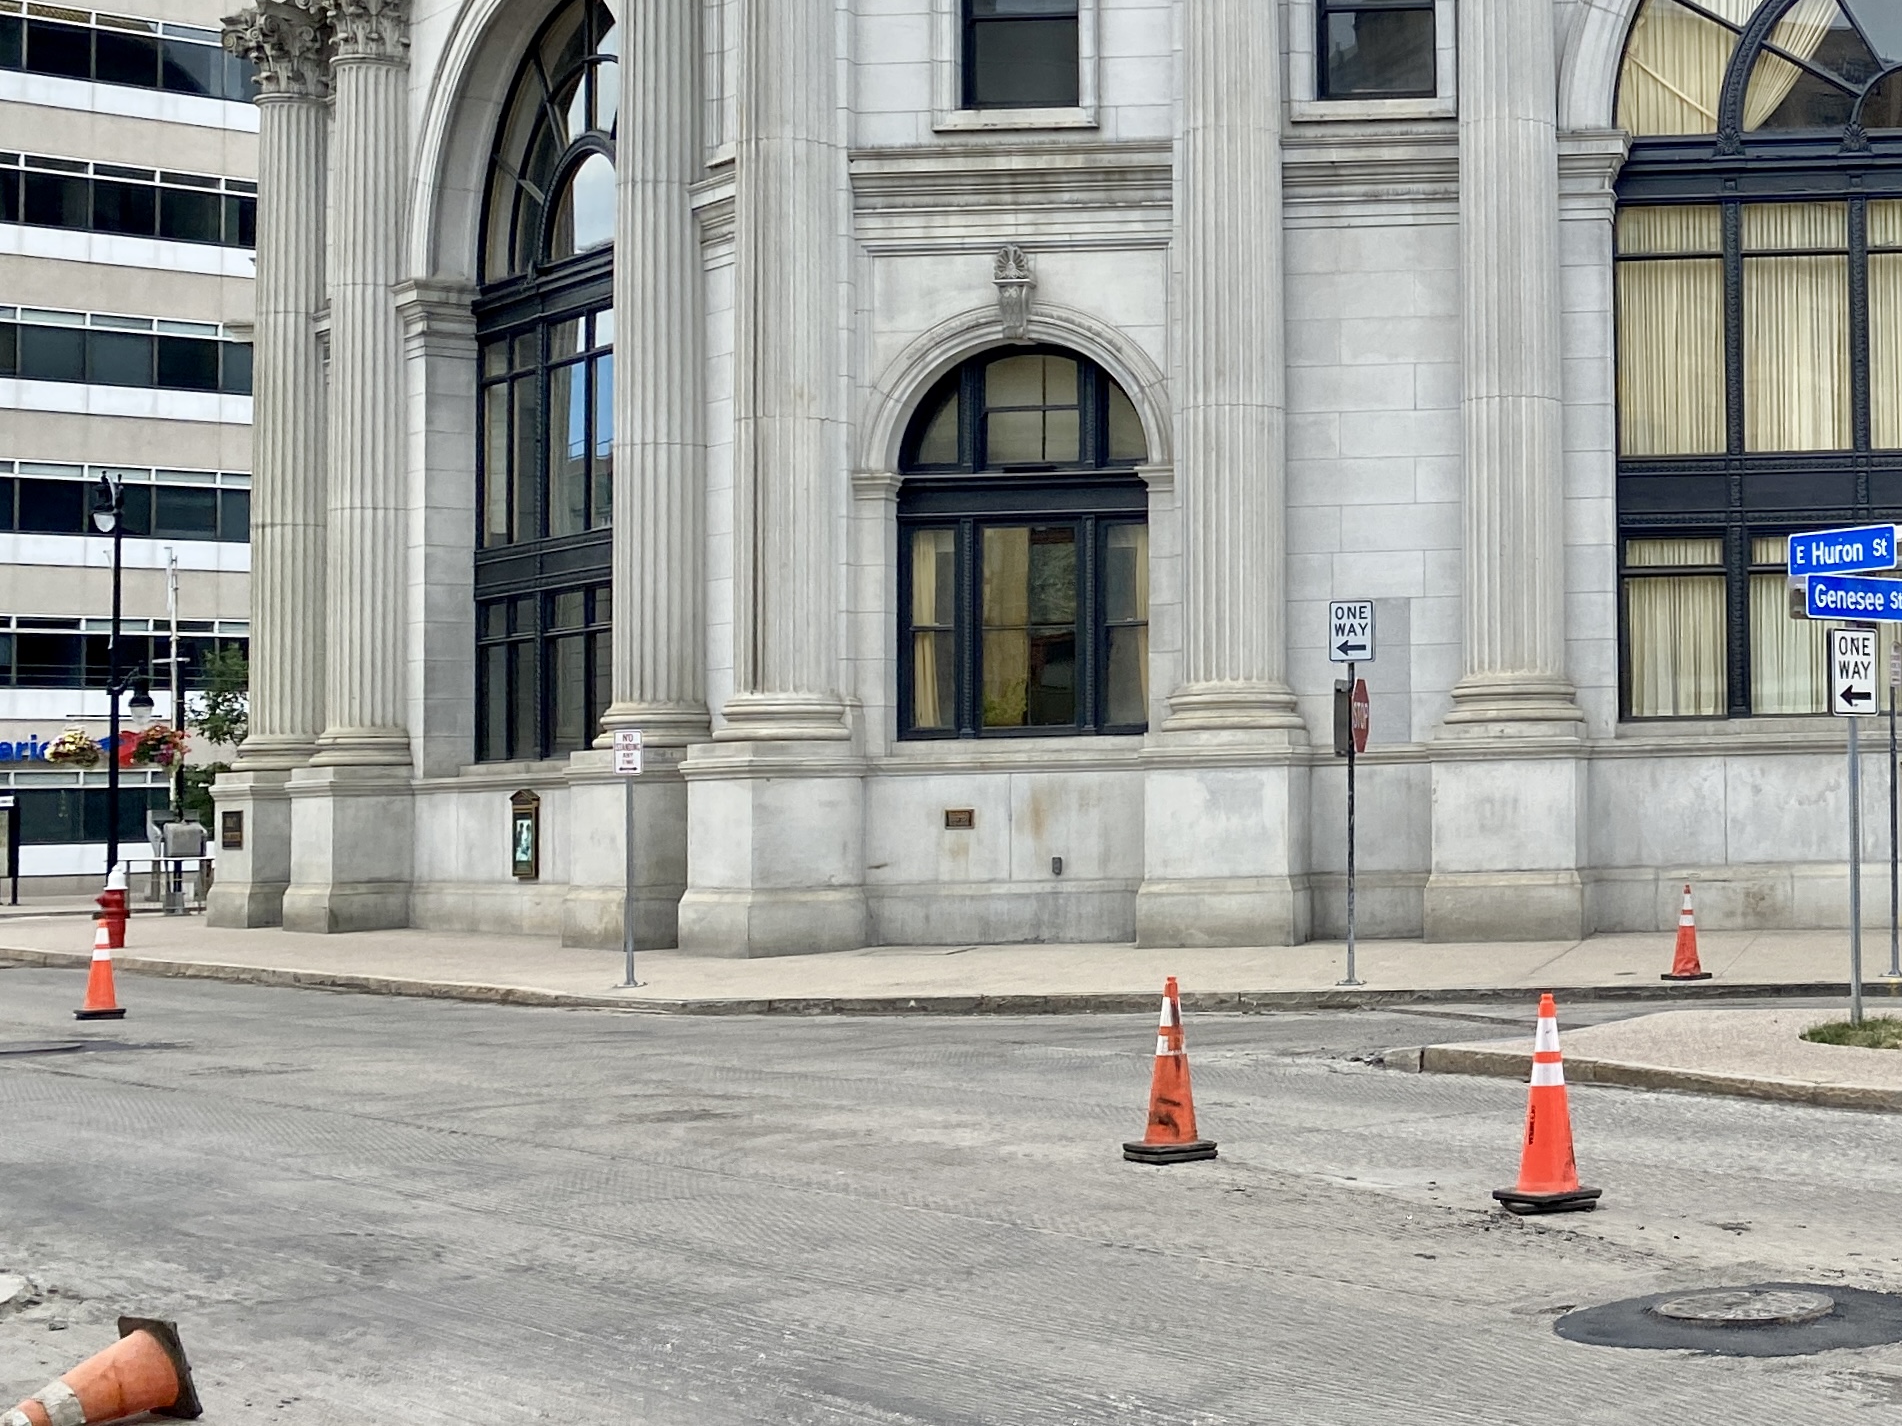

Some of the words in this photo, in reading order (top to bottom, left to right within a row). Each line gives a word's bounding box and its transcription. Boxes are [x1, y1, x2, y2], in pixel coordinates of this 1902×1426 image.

[1796, 546, 1806, 565] E
[1812, 541, 1864, 566] Huron
[1872, 537, 1888, 558] St
[1814, 583, 1885, 611] Genesee
[1334, 605, 1369, 621] ONE
[1334, 622, 1369, 637] WAY
[1838, 636, 1871, 657] ONE
[1838, 660, 1872, 680] WAY
[1353, 701, 1368, 730] STOP
[622, 733, 634, 743] NO
